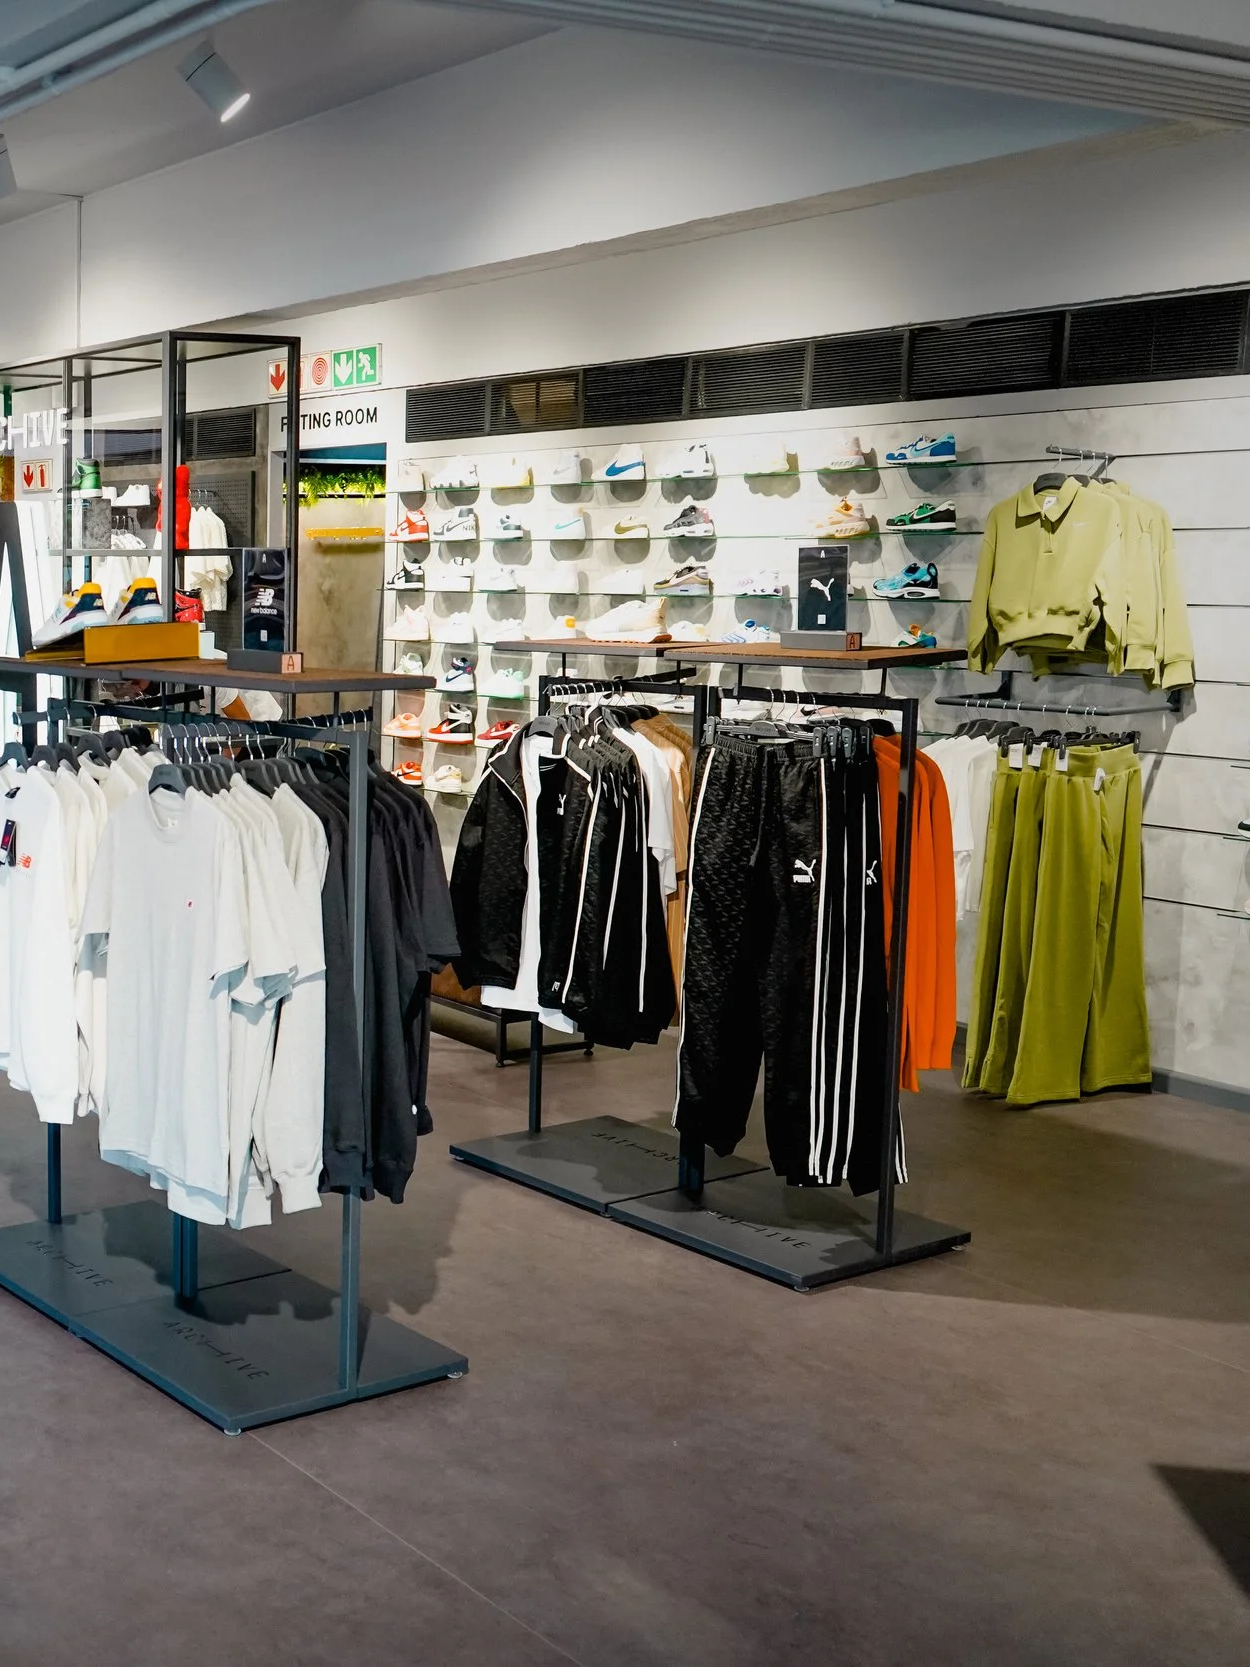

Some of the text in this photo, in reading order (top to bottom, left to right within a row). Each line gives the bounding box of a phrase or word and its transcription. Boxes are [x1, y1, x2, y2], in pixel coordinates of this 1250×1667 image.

[280, 406, 378, 433] FTING ROOM
[286, 655, 295, 671] A
